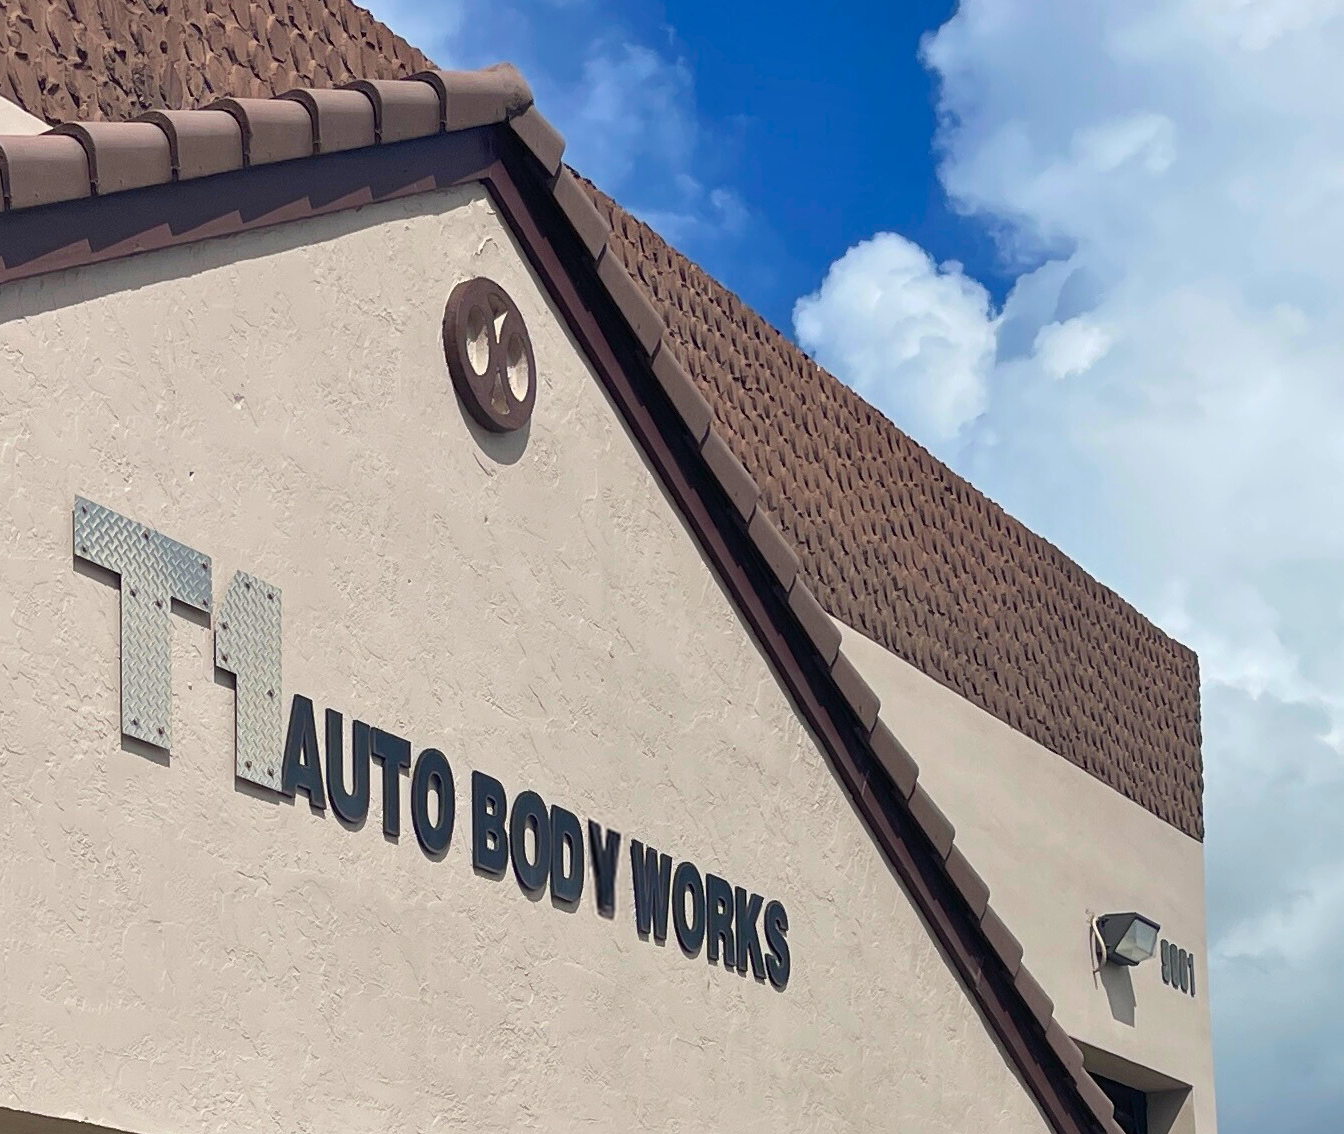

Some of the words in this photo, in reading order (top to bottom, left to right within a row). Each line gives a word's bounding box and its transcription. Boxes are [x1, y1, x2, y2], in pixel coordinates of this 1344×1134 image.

[72, 494, 284, 794] T1
[283, 694, 456, 857] AUTO
[470, 769, 623, 918] BODY
[630, 839, 792, 990] WORKS
